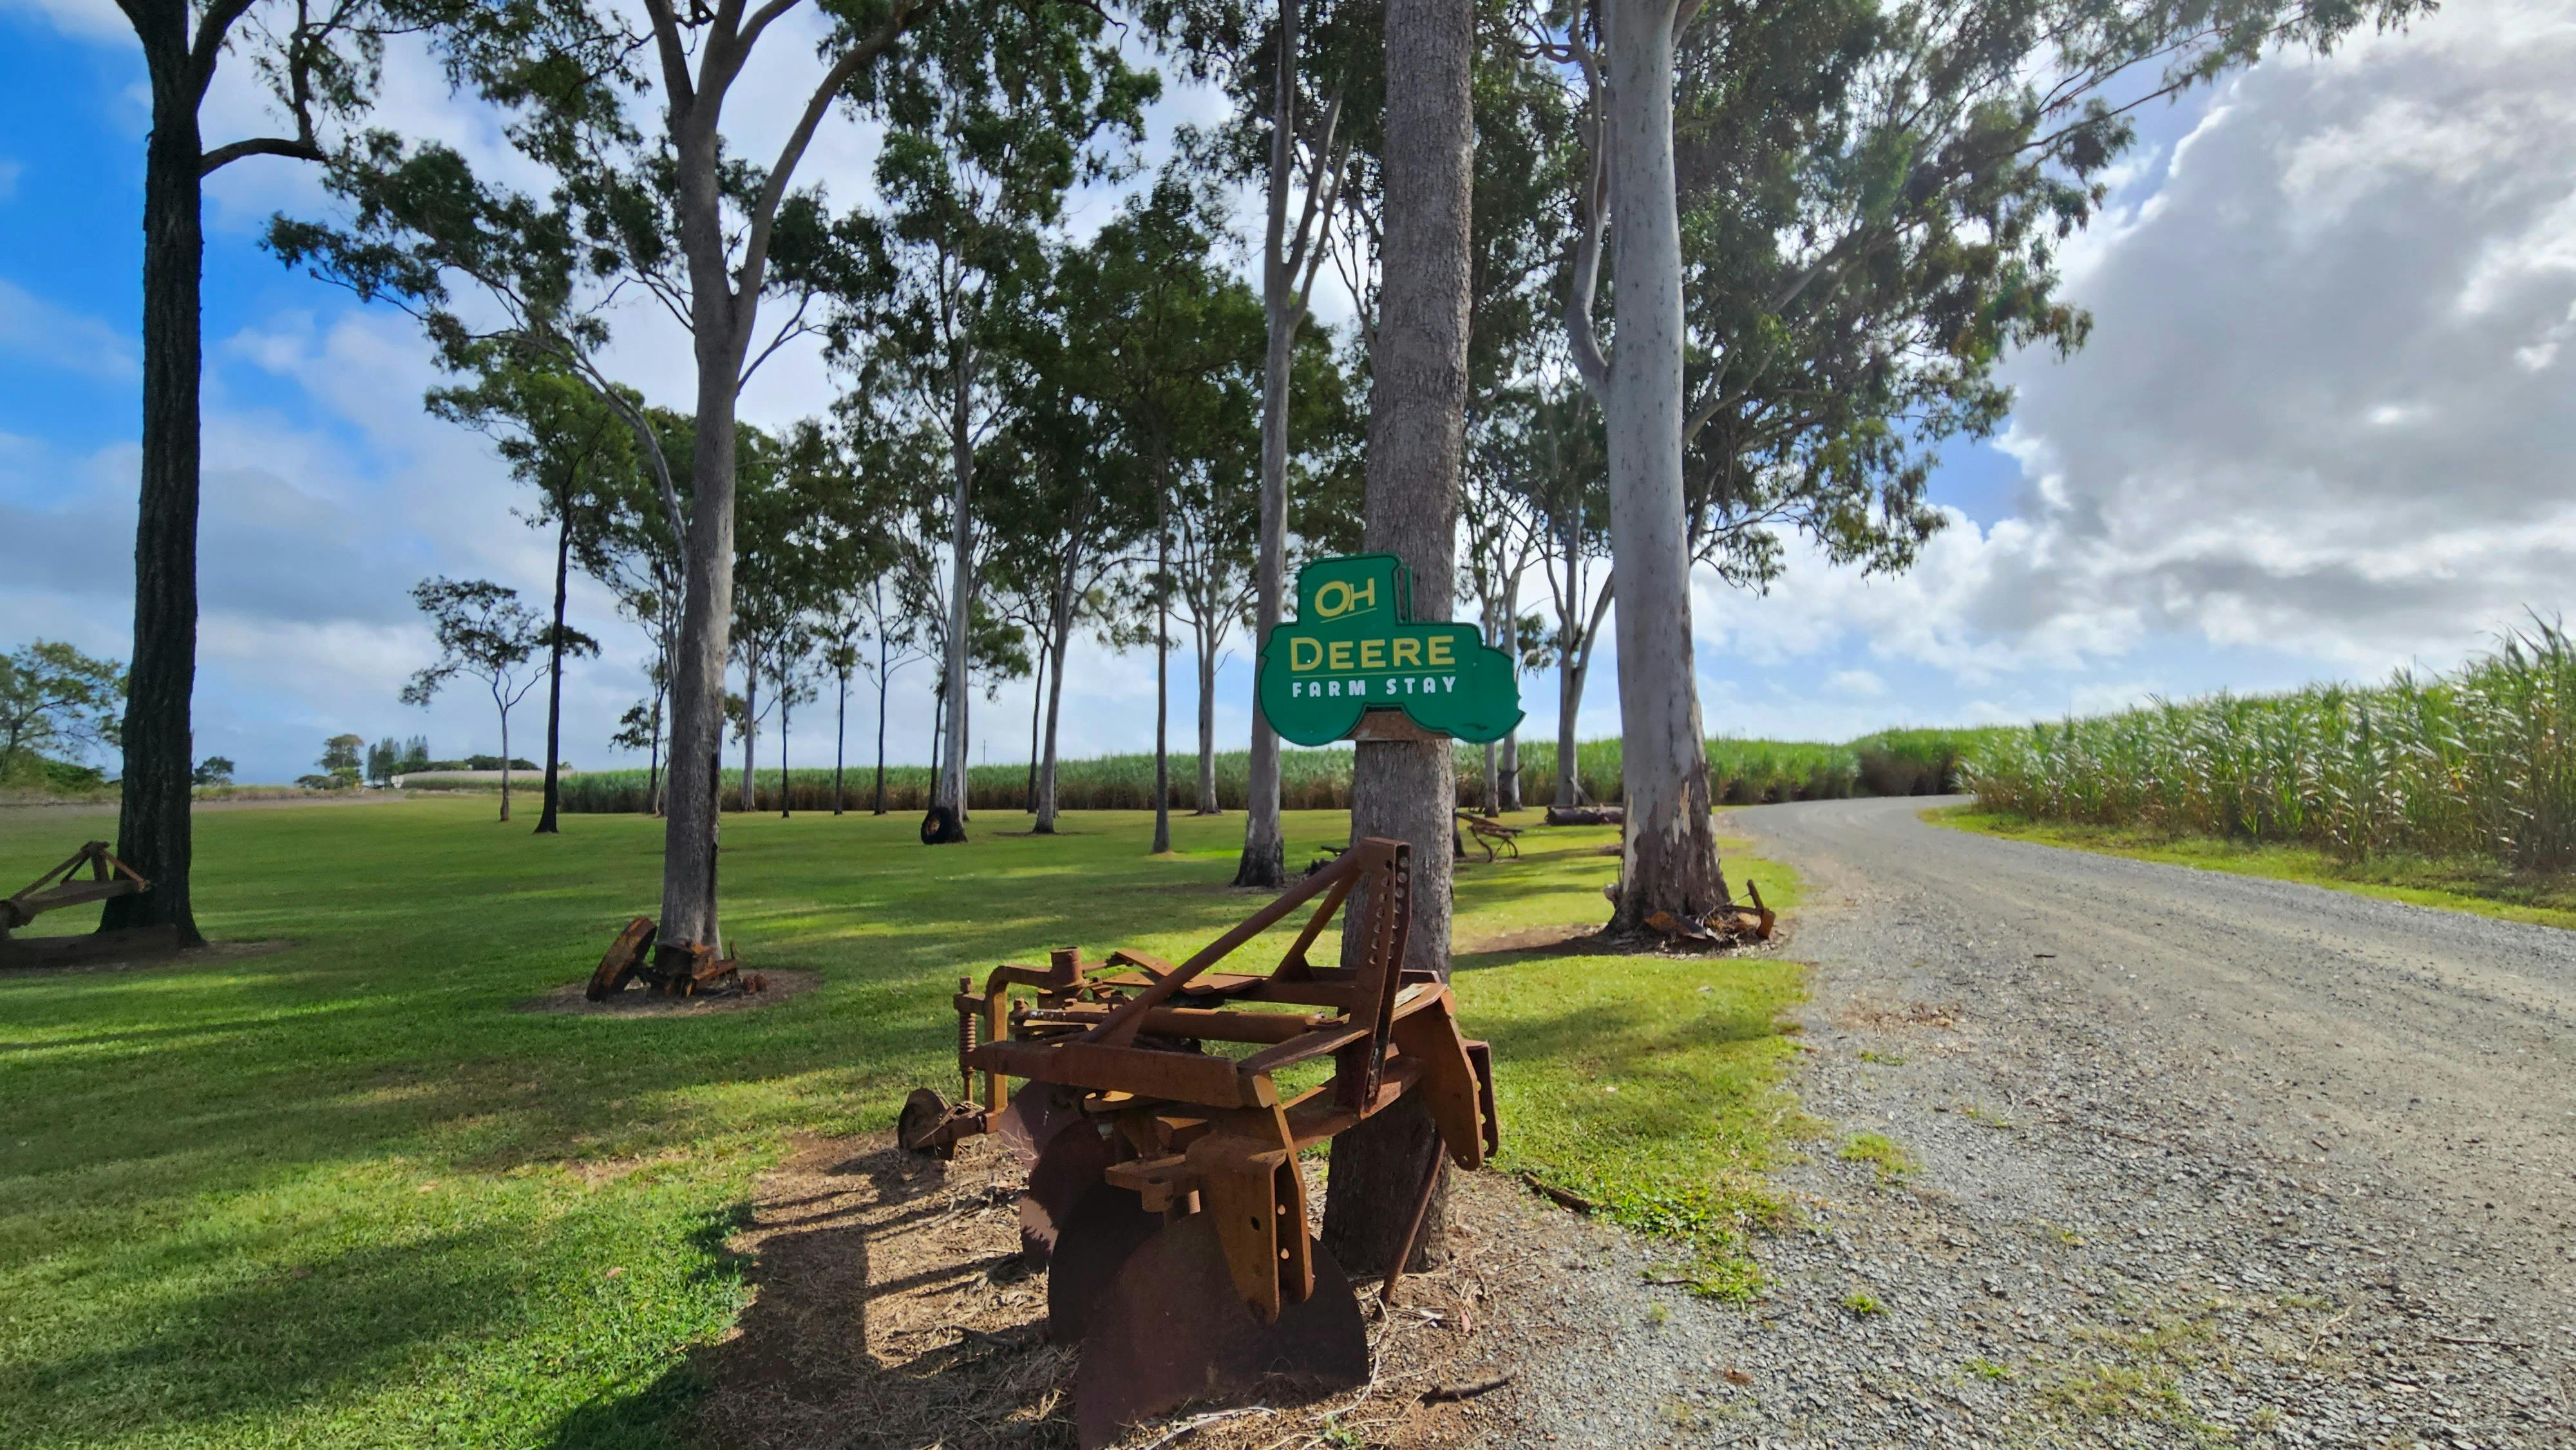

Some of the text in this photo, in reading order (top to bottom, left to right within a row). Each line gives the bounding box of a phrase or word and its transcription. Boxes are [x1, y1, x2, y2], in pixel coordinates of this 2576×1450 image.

[1314, 578, 1376, 617] OH
[1290, 636, 1455, 672] DEERE
[1293, 676, 1456, 698] FARM STAY
